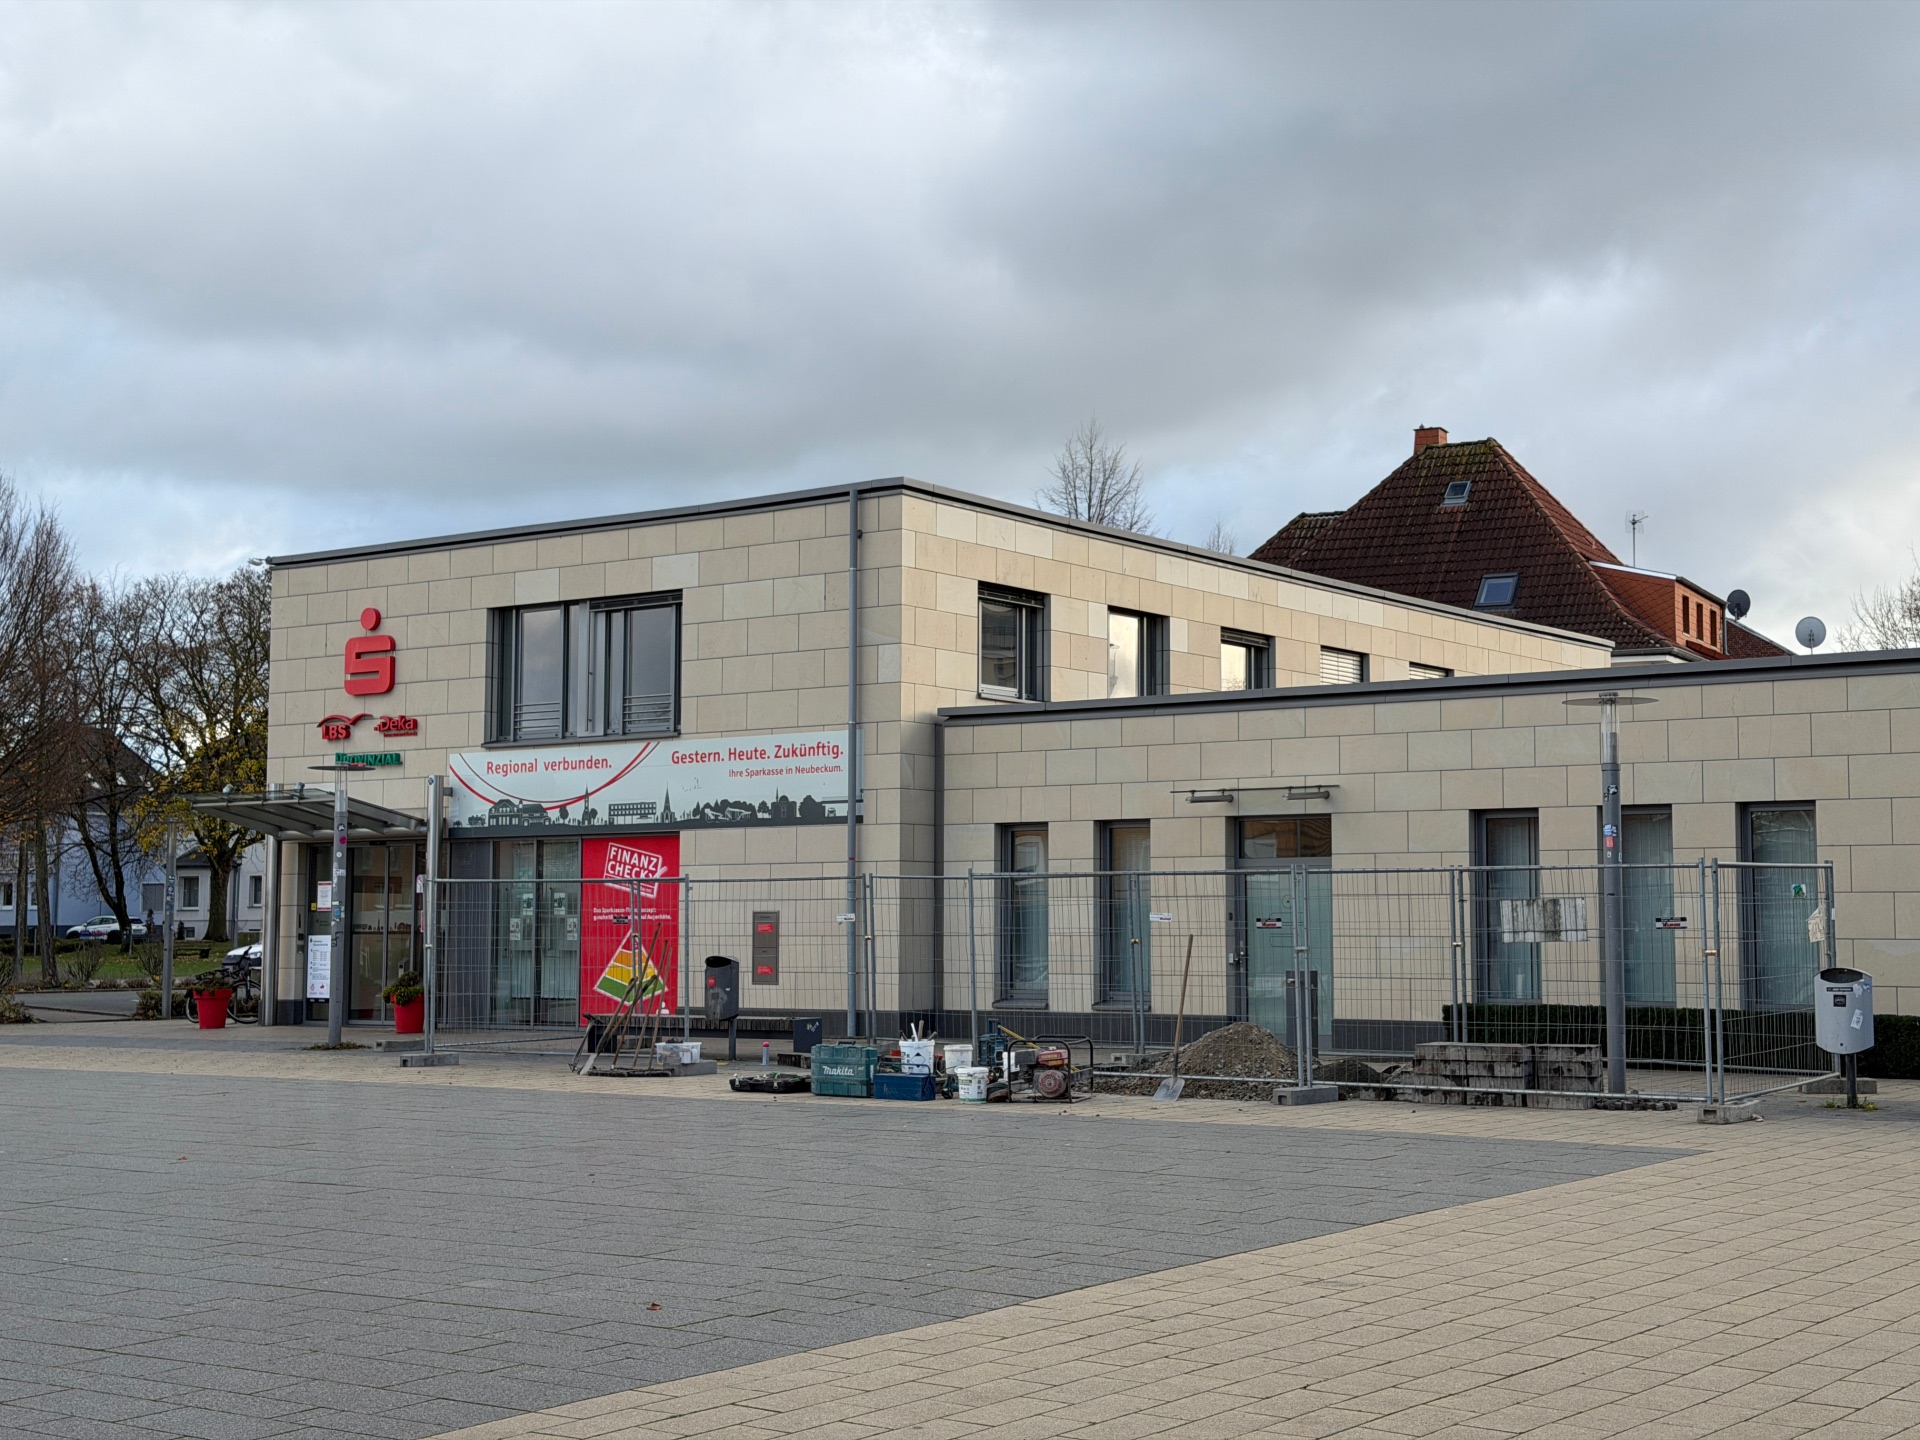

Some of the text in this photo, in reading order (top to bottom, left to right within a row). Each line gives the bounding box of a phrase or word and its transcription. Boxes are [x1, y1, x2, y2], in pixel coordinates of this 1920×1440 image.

[321, 724, 351, 741] LBS
[379, 715, 419, 732] Deka
[671, 741, 844, 765] Gestern. Heute. Zukünftig.
[486, 755, 613, 778] Regional verbunden.
[729, 764, 844, 779] Ihre Sparkasse in Neubeckum.
[609, 846, 658, 872] FINANZ
[607, 861, 650, 880] CHECK
[822, 1065, 855, 1076] Makita
